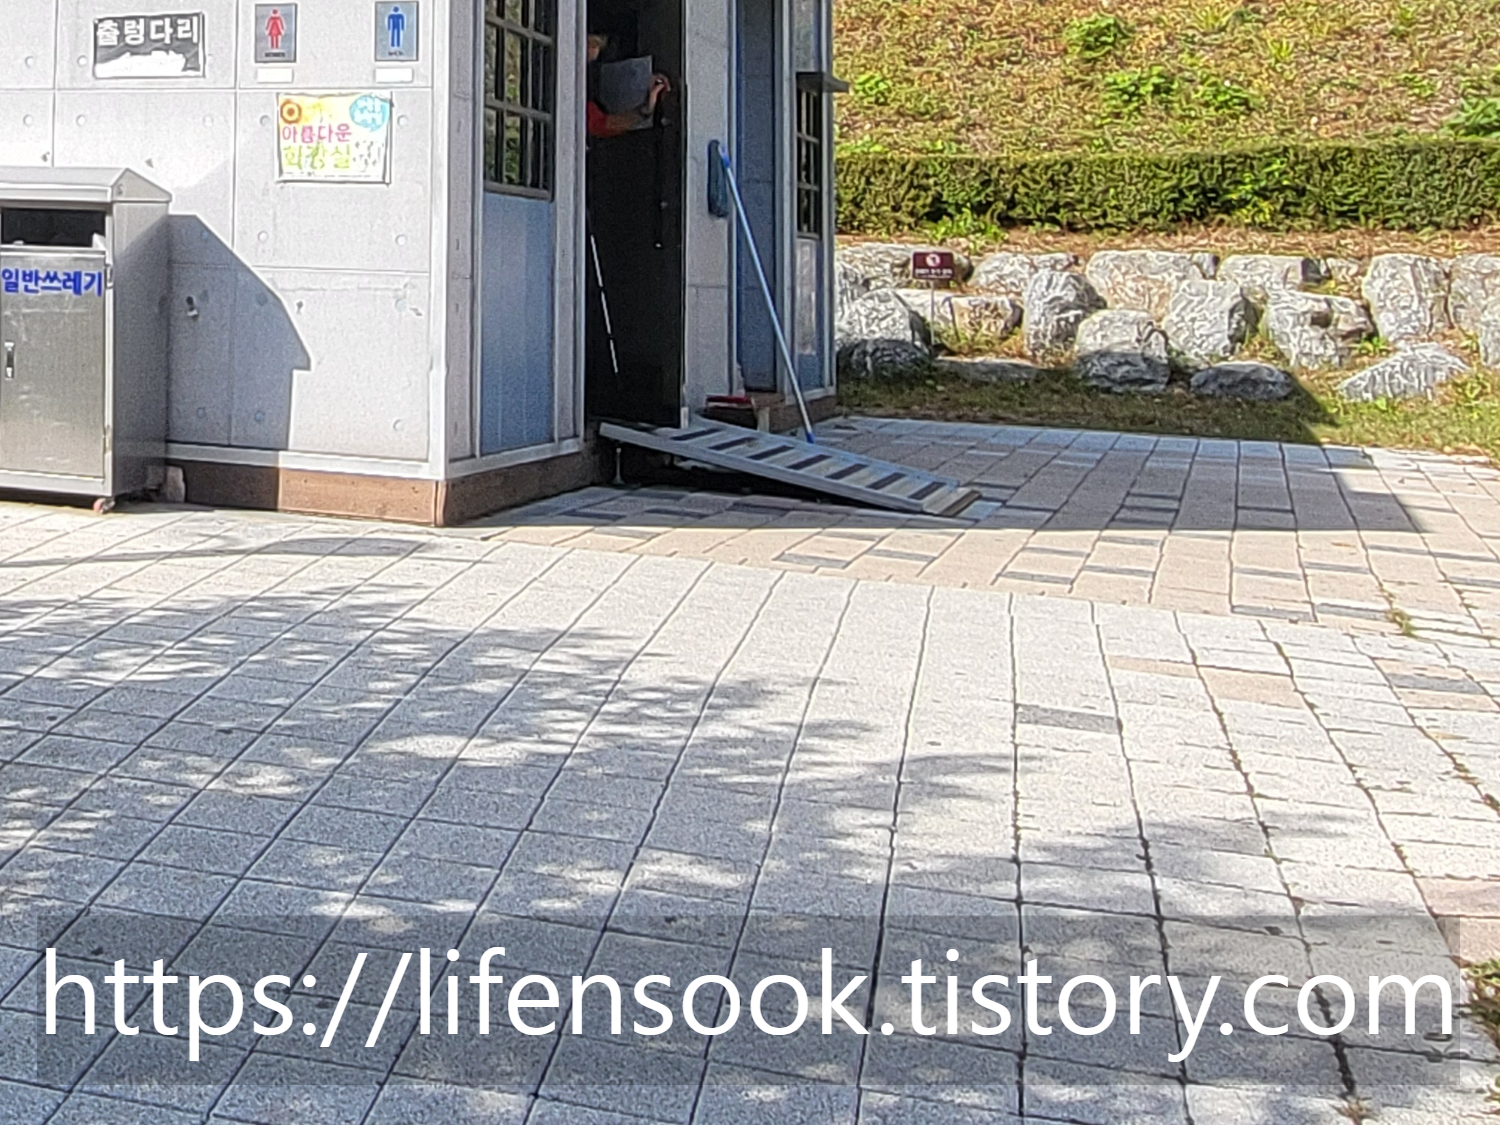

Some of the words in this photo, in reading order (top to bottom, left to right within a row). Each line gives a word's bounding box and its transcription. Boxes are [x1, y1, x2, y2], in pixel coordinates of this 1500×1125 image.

[96, 16, 198, 47] 출렁다리
[281, 123, 353, 144] 아름다운
[1, 268, 103, 297] 일반쓰레기
